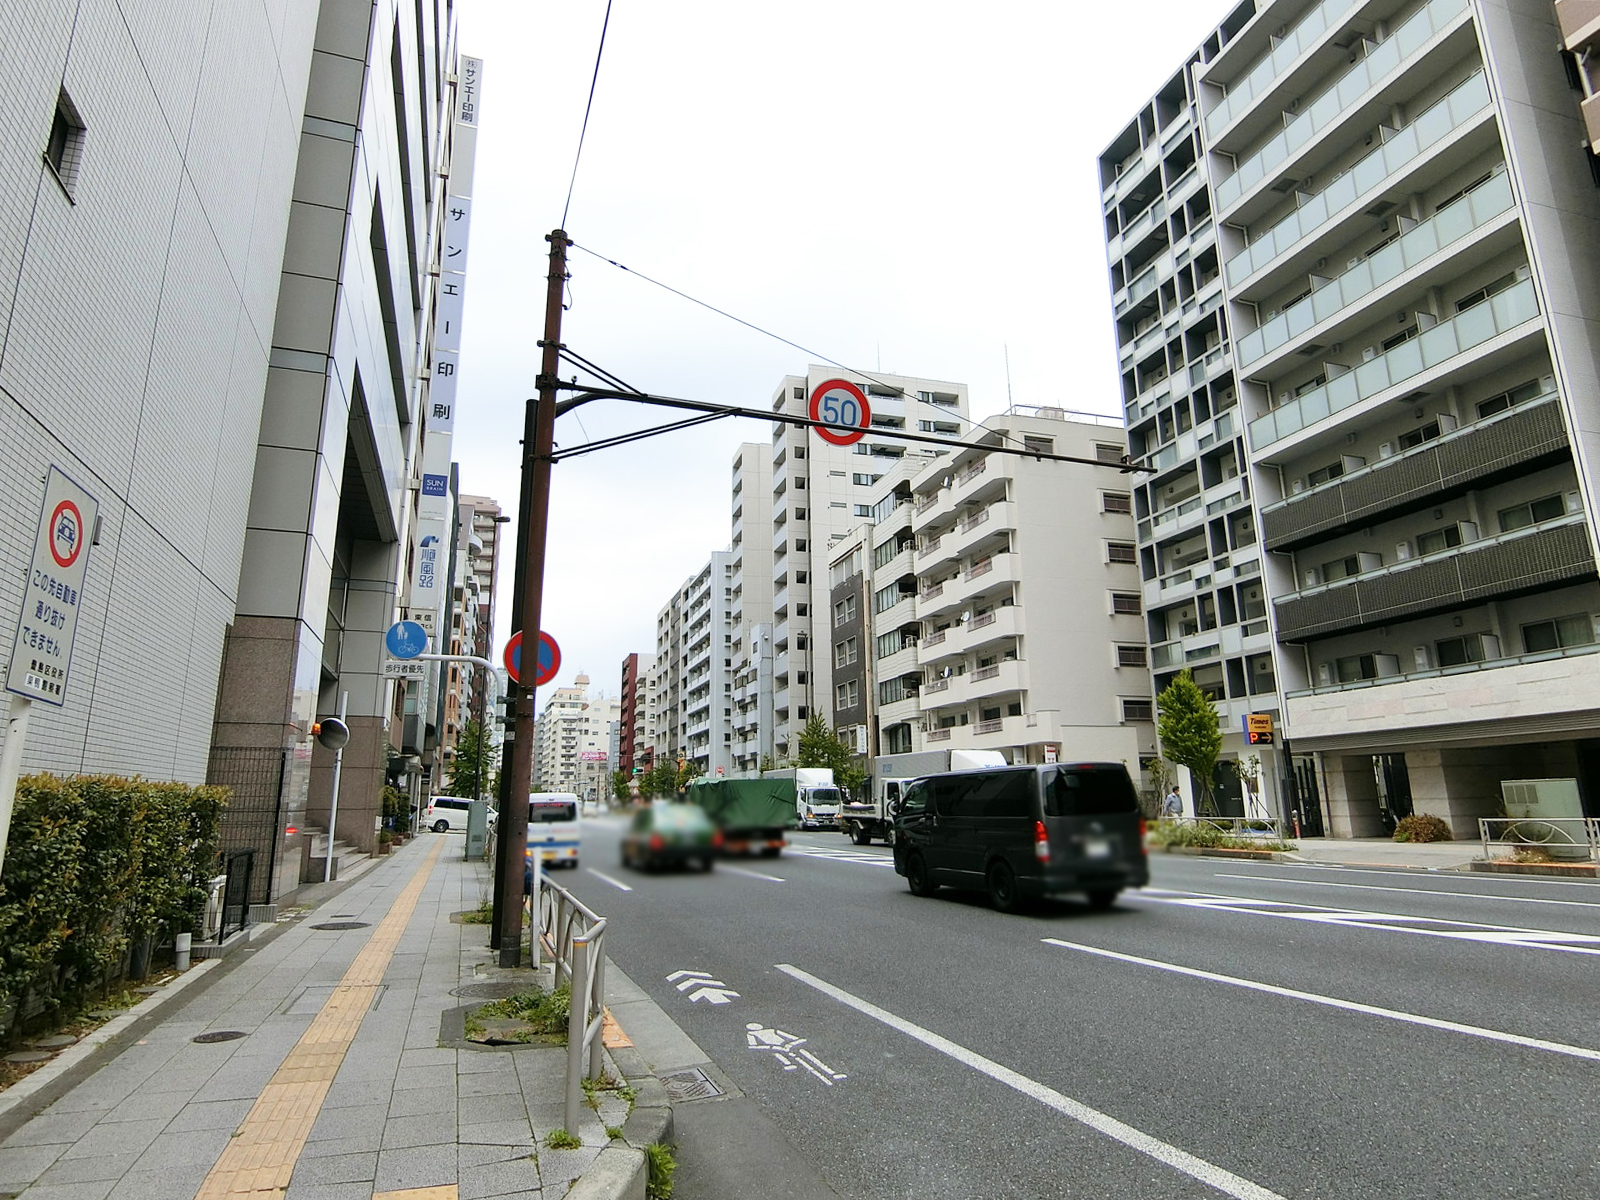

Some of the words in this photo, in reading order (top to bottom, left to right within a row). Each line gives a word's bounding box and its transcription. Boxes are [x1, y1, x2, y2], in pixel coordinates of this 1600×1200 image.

[432, 208, 466, 420] サンエー印刷
[823, 395, 857, 426] 50
[426, 479, 444, 487] SUN
[32, 569, 78, 606] この先自動車
[35, 600, 66, 630] 通り抜け
[385, 664, 425, 674] 歩行者優先
[1250, 717, 1269, 725] Times
[1250, 732, 1259, 744] P
